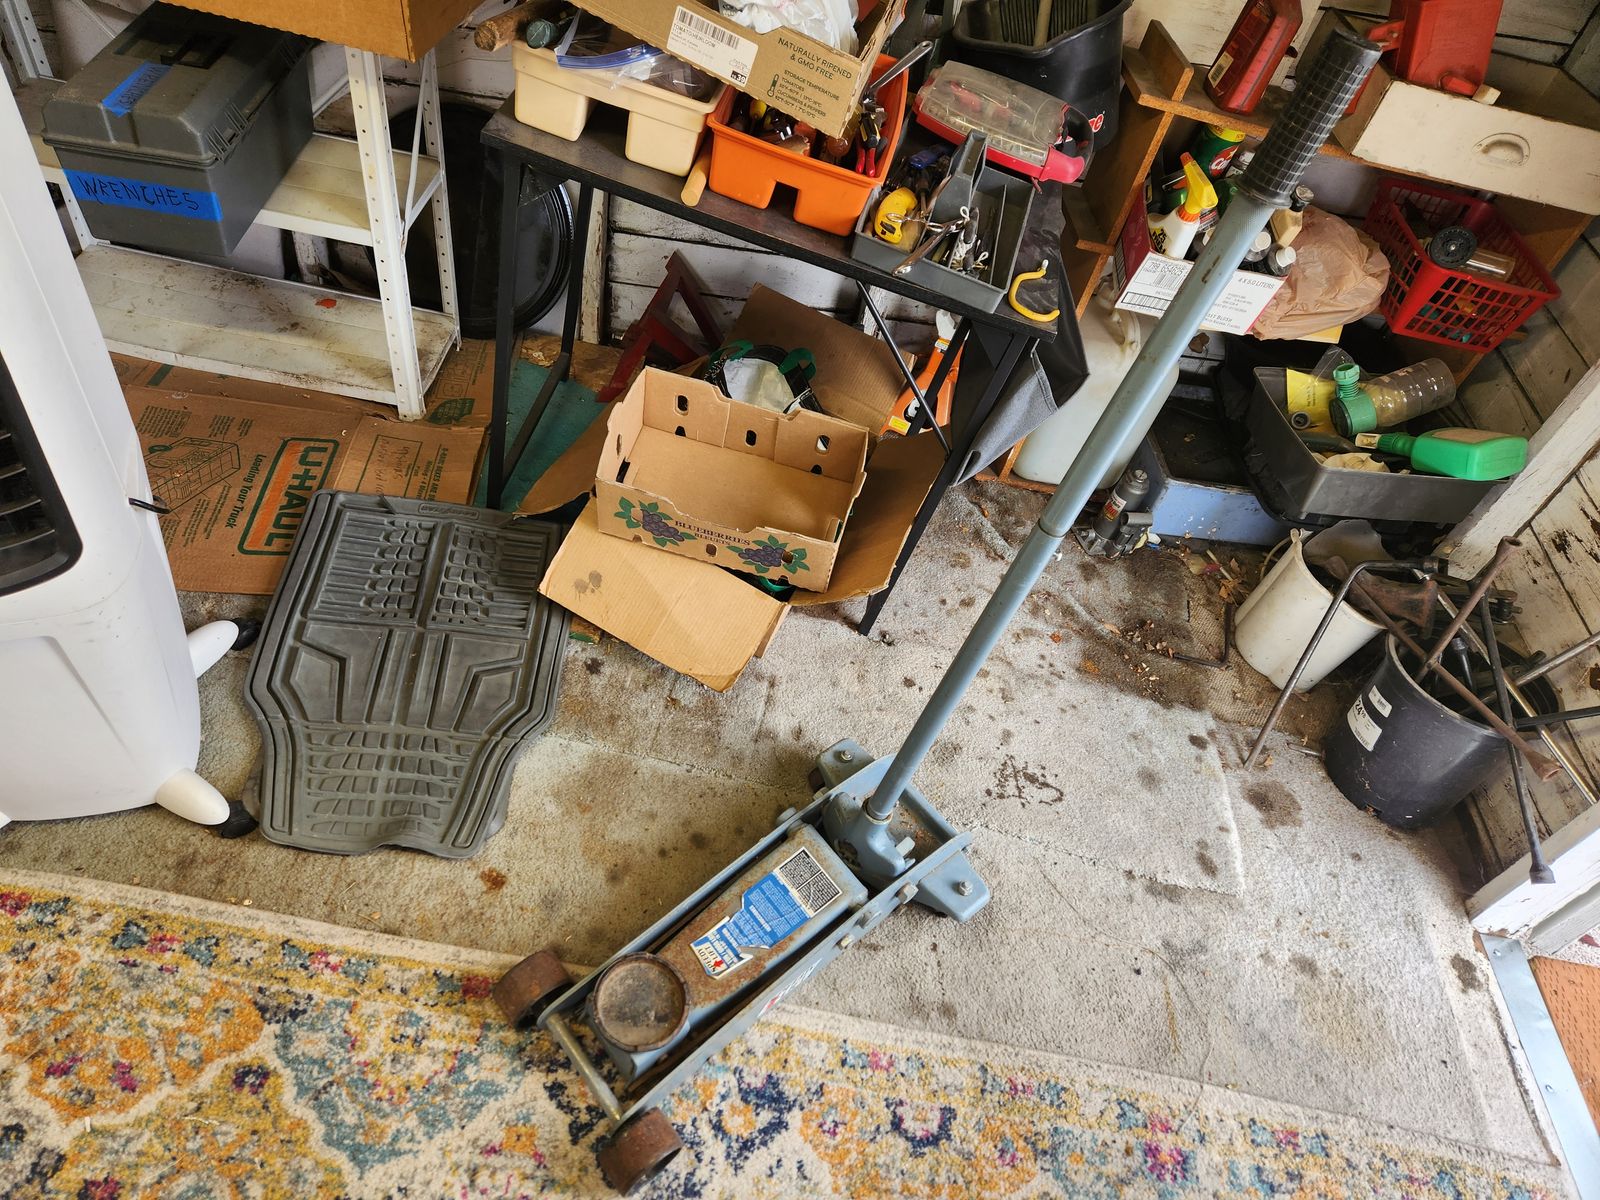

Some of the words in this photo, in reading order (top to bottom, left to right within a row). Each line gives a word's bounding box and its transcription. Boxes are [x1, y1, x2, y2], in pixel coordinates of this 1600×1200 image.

[778, 38, 821, 62] NATURALLY
[821, 59, 852, 79] RIPENED
[797, 57, 815, 70] GMO
[815, 66, 834, 80] FREE
[781, 77, 805, 92] TOMATOES
[784, 69, 806, 84] STORAGE
[806, 80, 839, 100] TEMPERATURE
[76, 175, 200, 211] WRENCHES
[243, 453, 267, 483] Loading
[236, 485, 253, 503] Your
[225, 505, 245, 529] Truck
[675, 520, 751, 546] BLUEBERRIES
[698, 948, 717, 973] SPEEDY
[705, 945, 719, 964] LIFT
